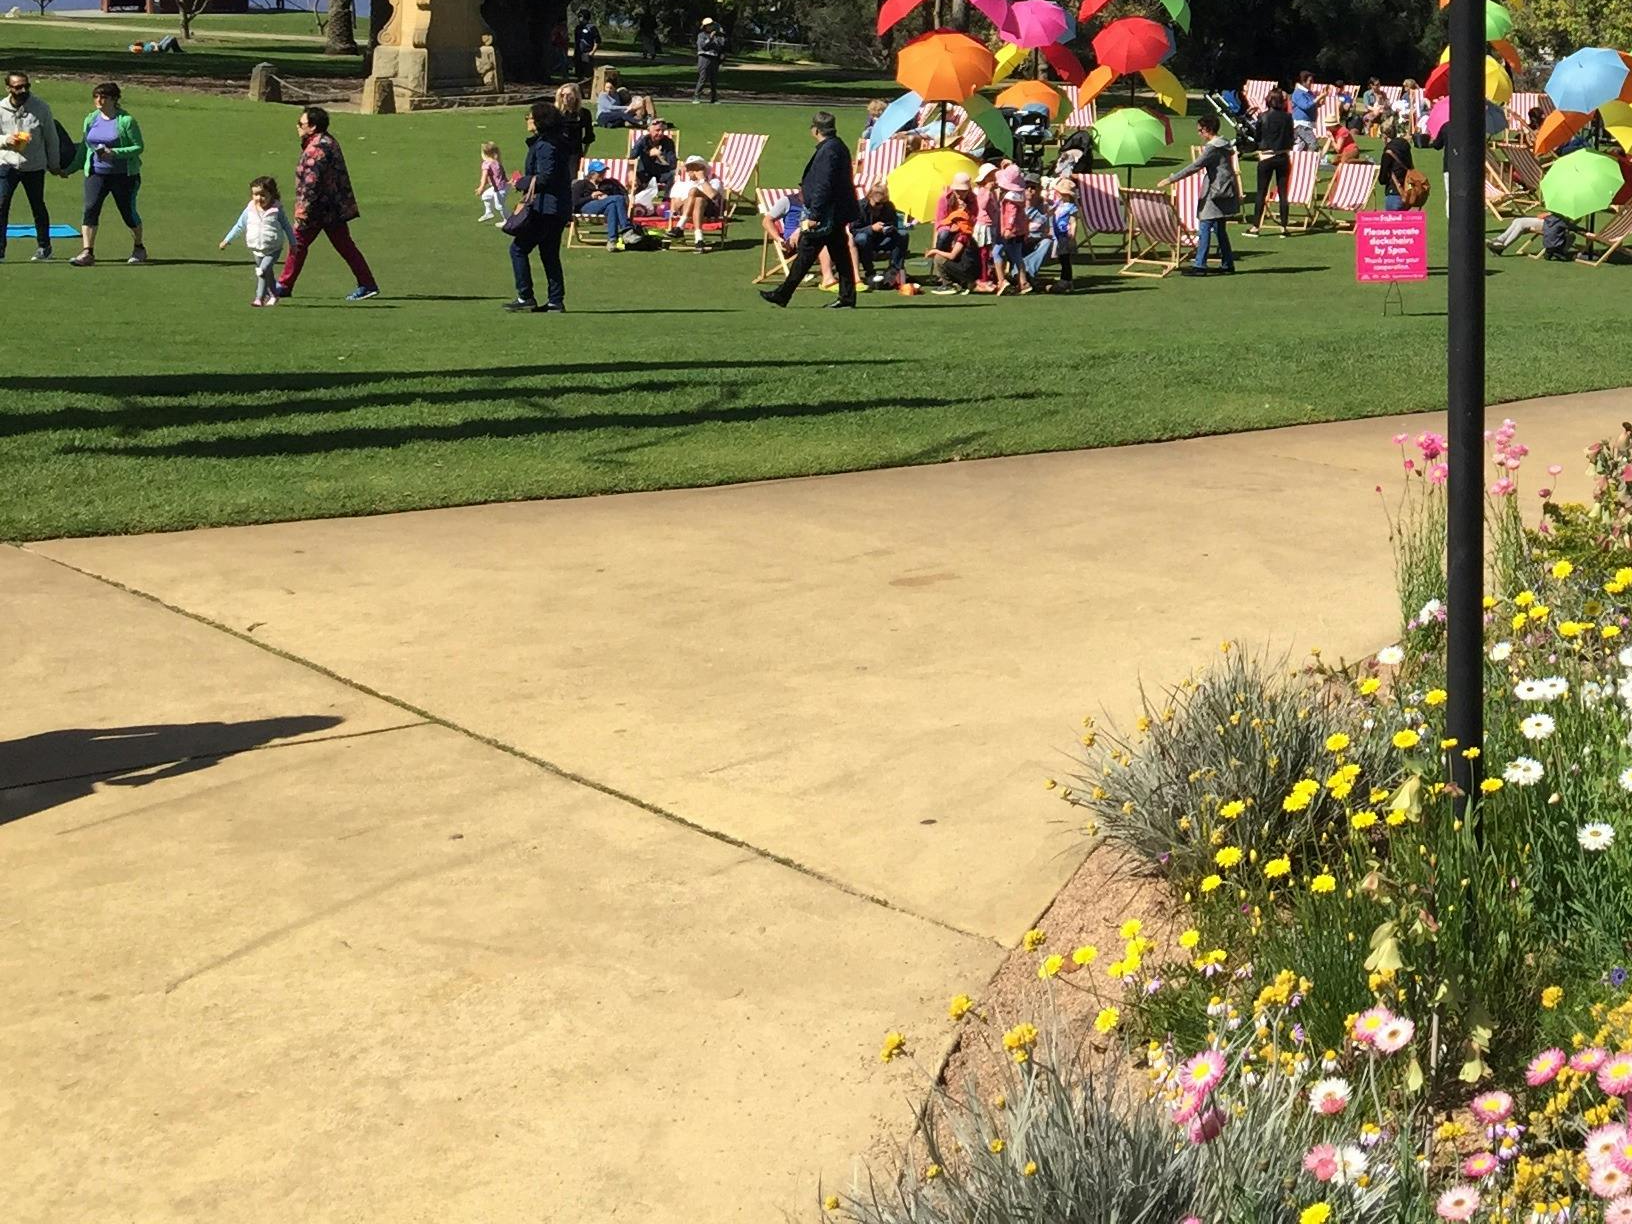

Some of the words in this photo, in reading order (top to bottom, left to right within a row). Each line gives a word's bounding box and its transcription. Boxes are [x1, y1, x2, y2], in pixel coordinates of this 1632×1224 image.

[1363, 228, 1390, 236] Please
[1369, 237, 1414, 245] deckchairs
[1374, 246, 1386, 255] by
